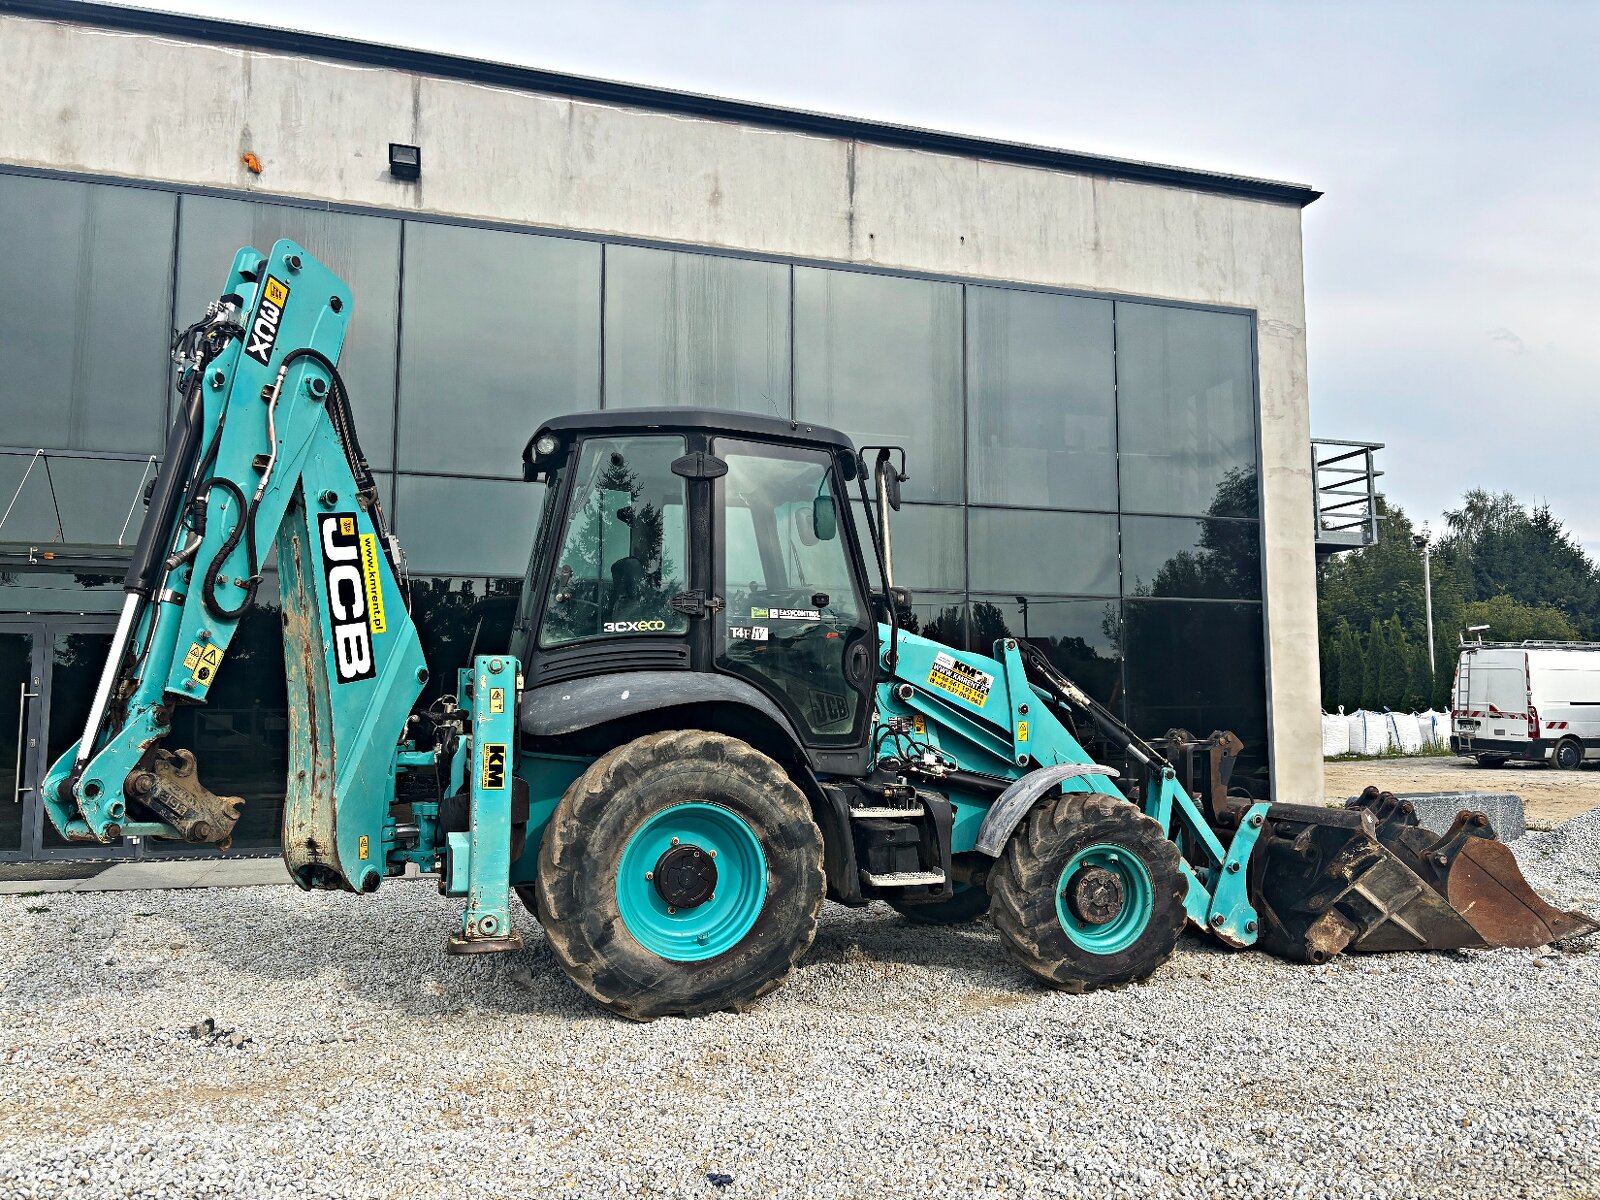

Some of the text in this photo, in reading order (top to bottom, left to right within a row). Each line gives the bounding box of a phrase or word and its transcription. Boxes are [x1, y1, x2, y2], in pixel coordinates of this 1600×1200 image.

[247, 300, 280, 362] 3CX
[322, 517, 371, 679] JCB
[364, 537, 384, 631] www.kmrent.pl
[953, 660, 976, 677] KM
[487, 745, 505, 788] KM
